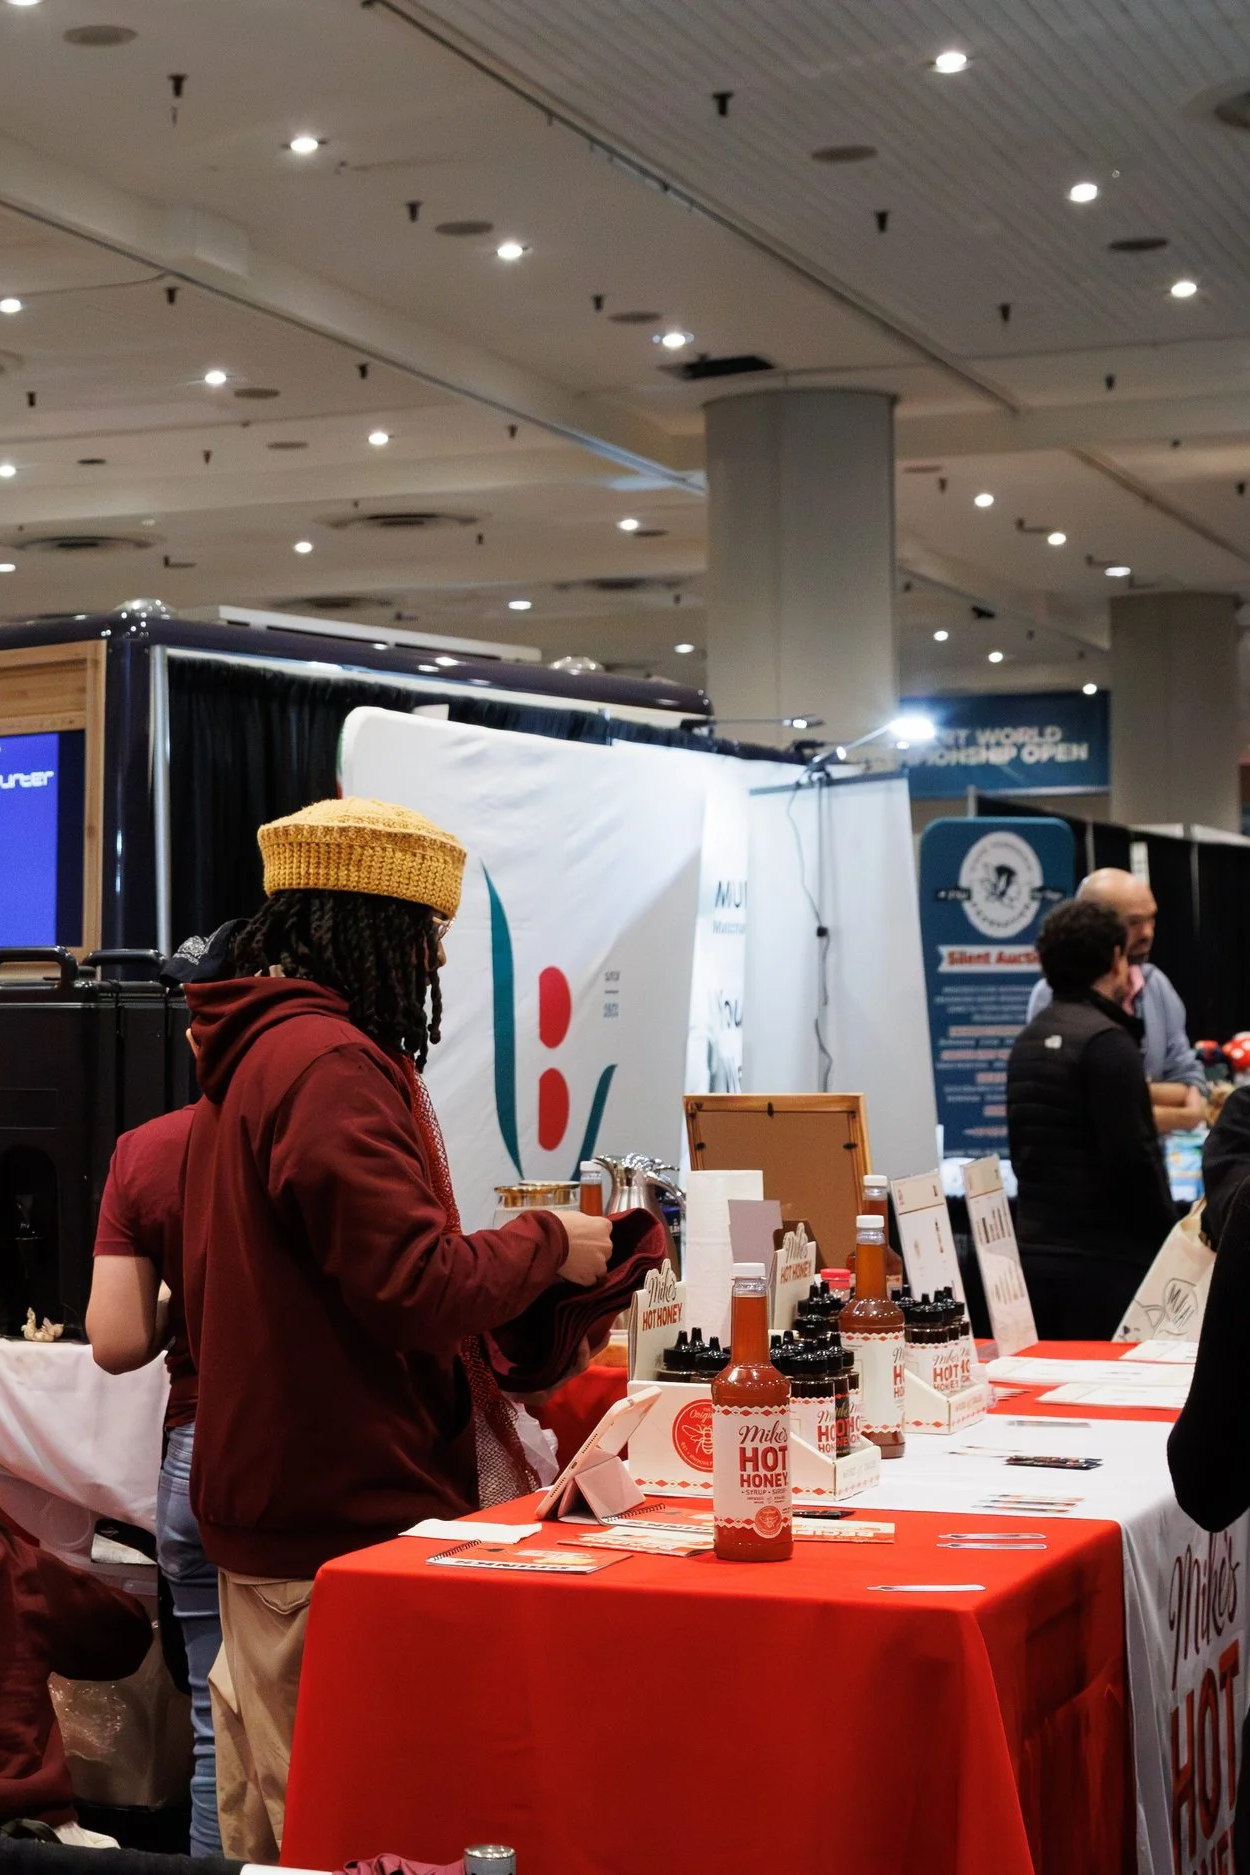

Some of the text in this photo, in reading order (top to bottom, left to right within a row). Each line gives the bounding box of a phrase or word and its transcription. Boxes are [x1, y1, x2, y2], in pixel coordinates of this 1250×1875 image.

[975, 725, 1063, 745] WORLD
[1020, 743, 1089, 765] OPEN
[739, 1445, 788, 1472] HOT
[740, 1472, 788, 1488] HONEY
